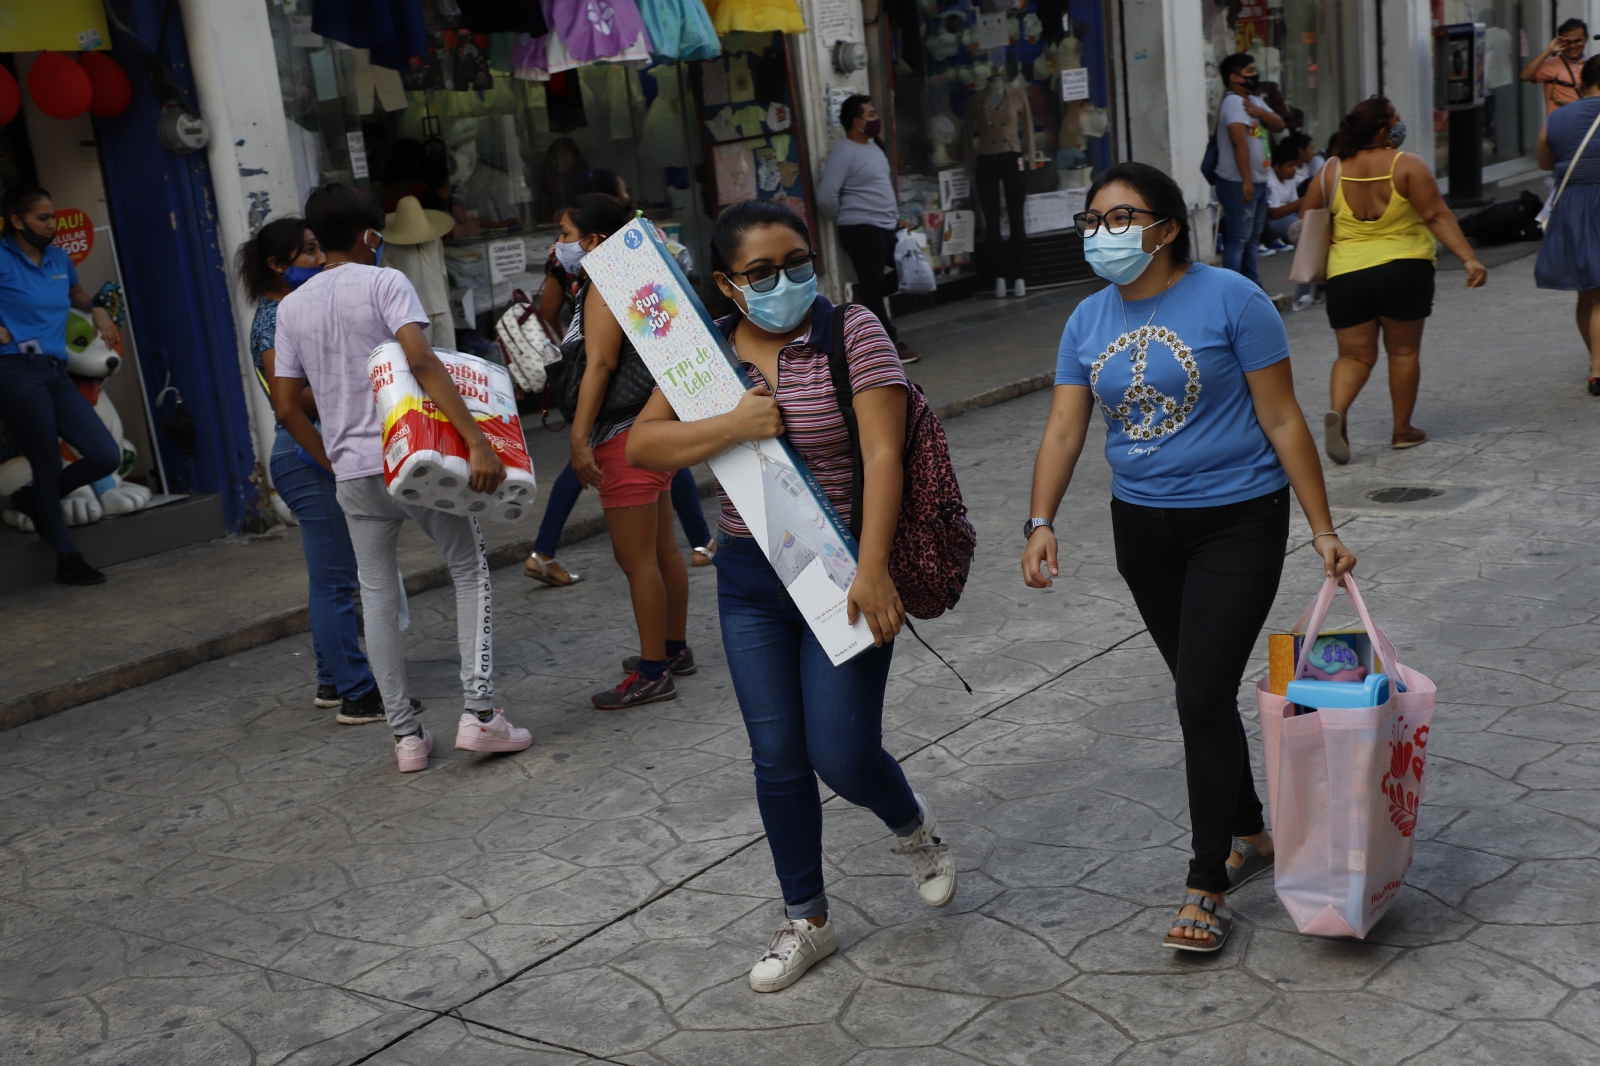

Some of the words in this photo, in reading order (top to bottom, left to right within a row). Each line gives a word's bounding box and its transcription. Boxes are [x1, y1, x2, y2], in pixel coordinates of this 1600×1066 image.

[636, 292, 659, 313] fun
[649, 307, 660, 317] &
[648, 310, 670, 332] sun
[662, 356, 695, 387] Tipi
[695, 346, 712, 365] de
[682, 370, 713, 395] tela
